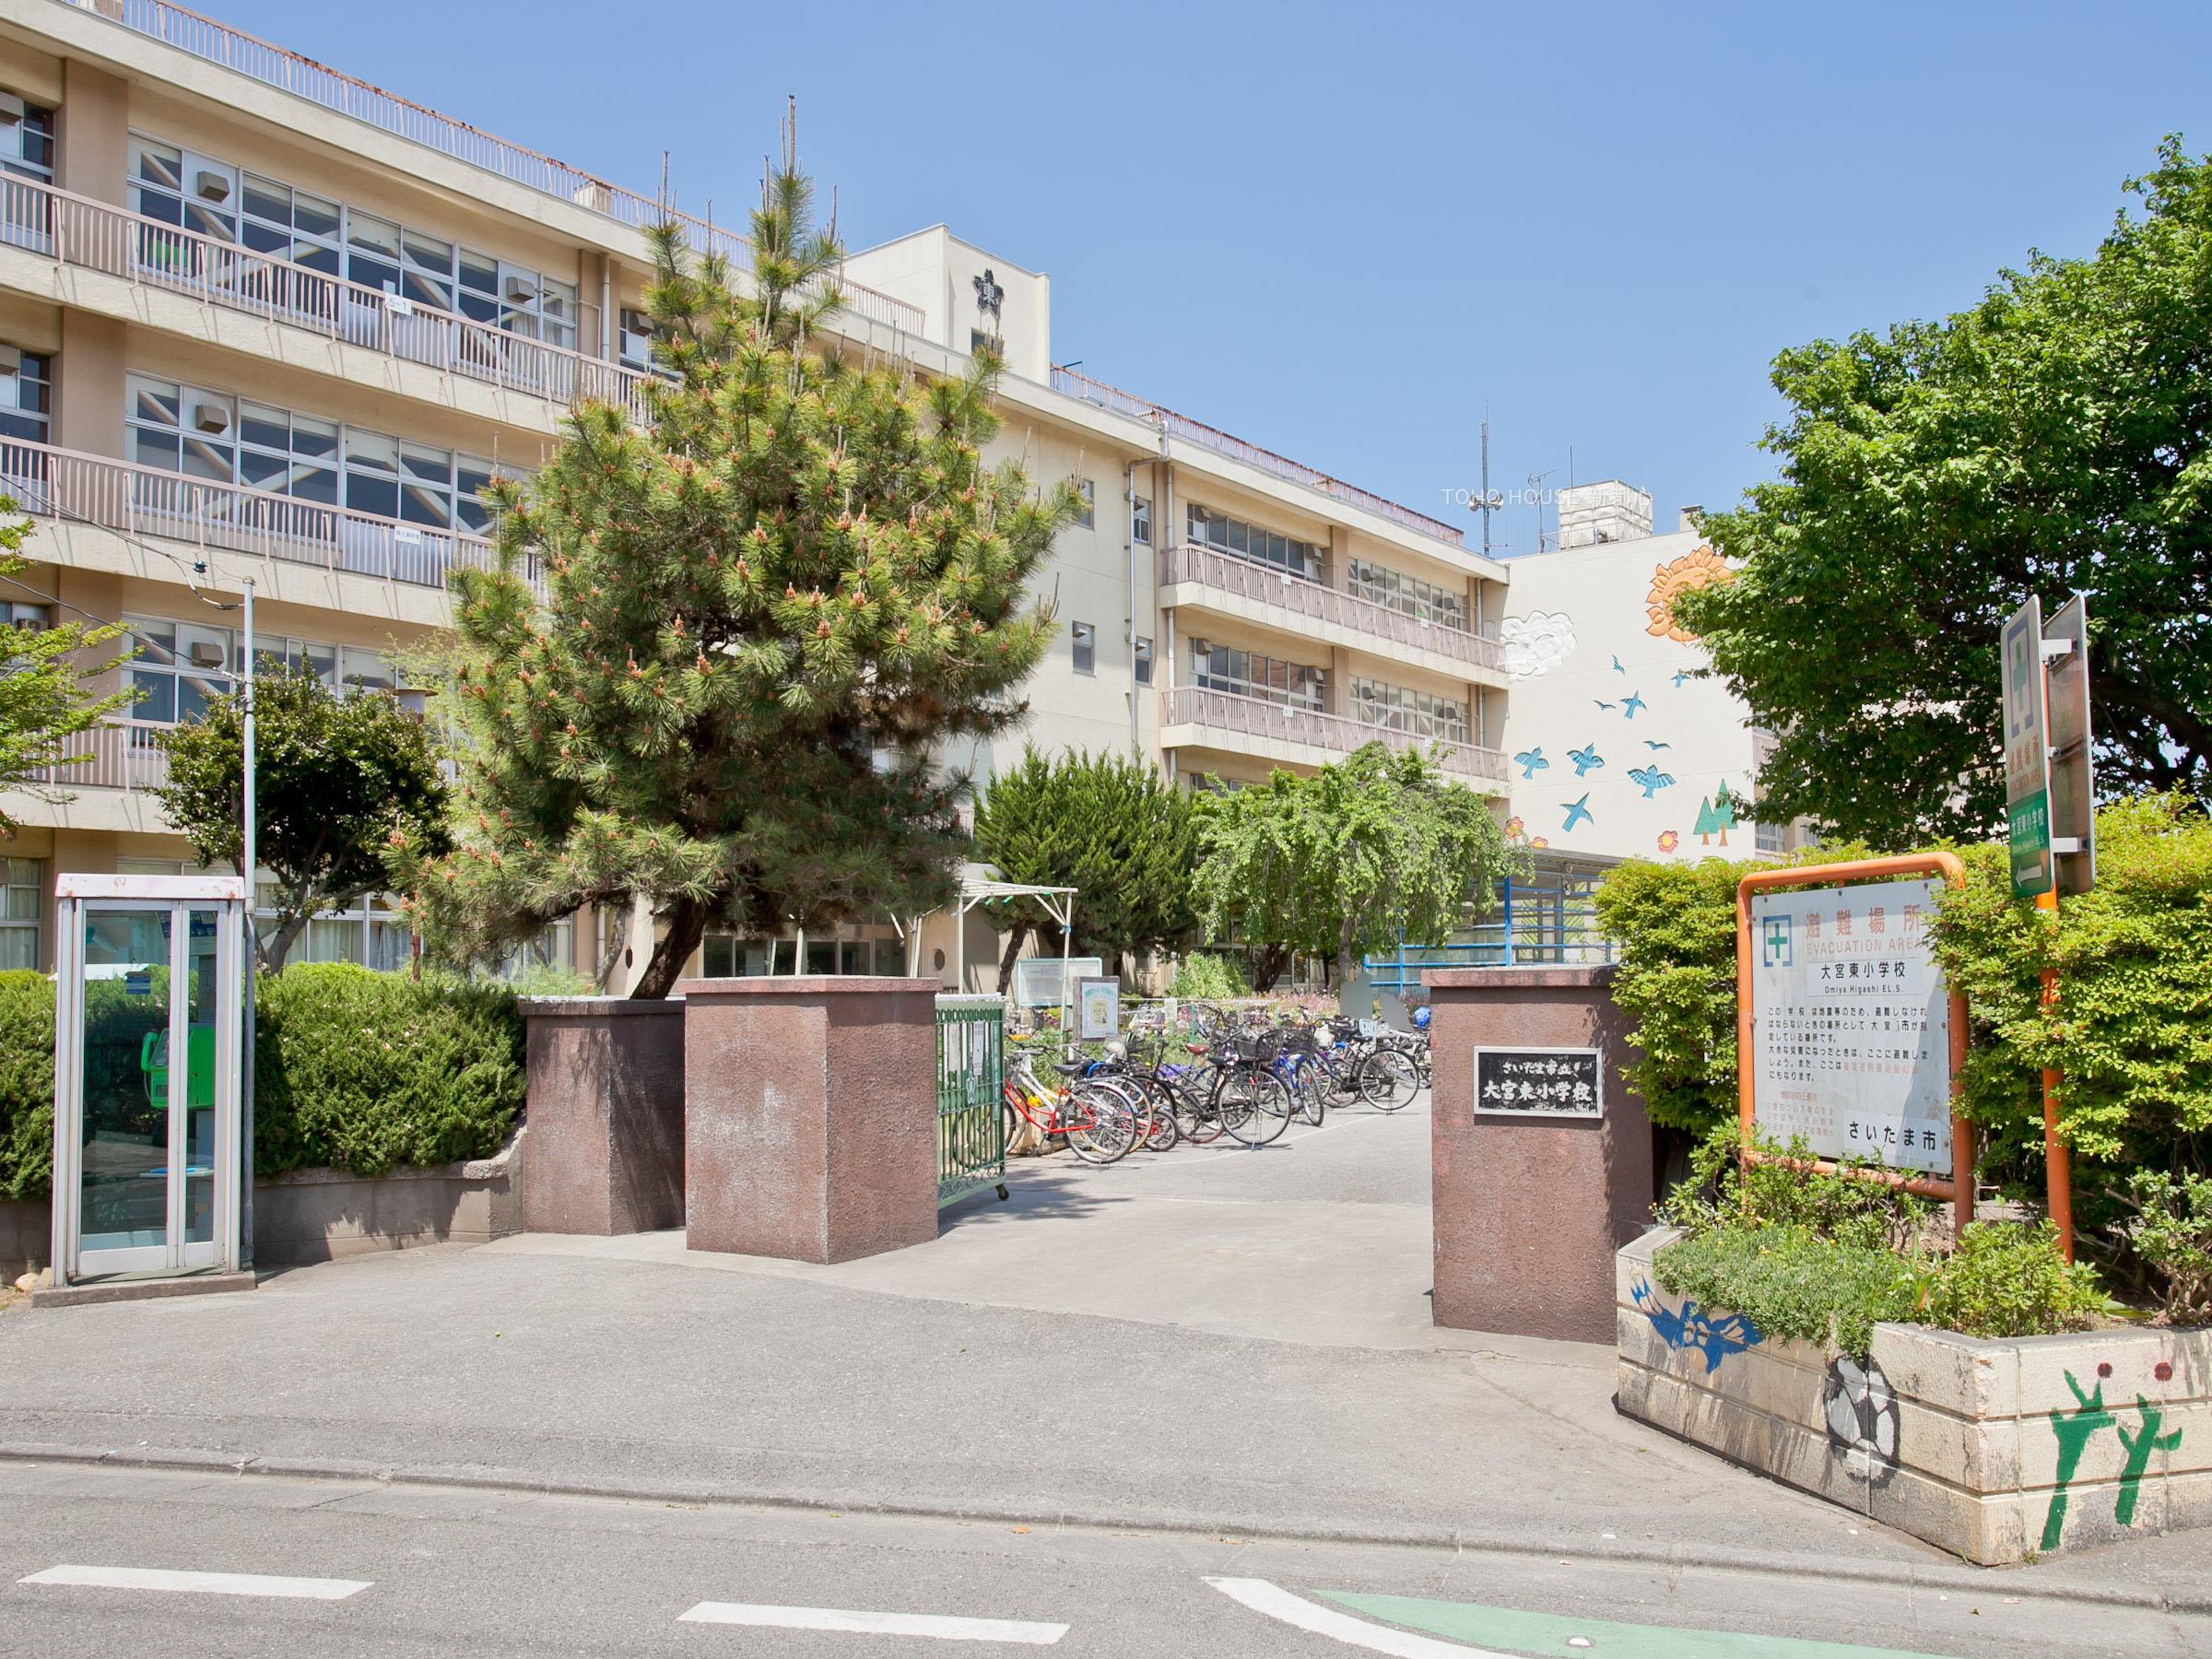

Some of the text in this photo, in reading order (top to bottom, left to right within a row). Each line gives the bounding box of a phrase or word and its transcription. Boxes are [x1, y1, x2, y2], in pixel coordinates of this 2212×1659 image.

[389, 297, 406, 312] 5-1
[1806, 903, 1921, 939] 避難場所
[1806, 938, 1882, 955] EVACUATION
[1820, 960, 1906, 980] 大宮東小学校
[1824, 985, 1847, 995] Omiya
[1850, 984, 1879, 995] Higashi
[1482, 1078, 1594, 1102] 大宮東小学校
[1849, 1120, 1936, 1151] さいたま市
